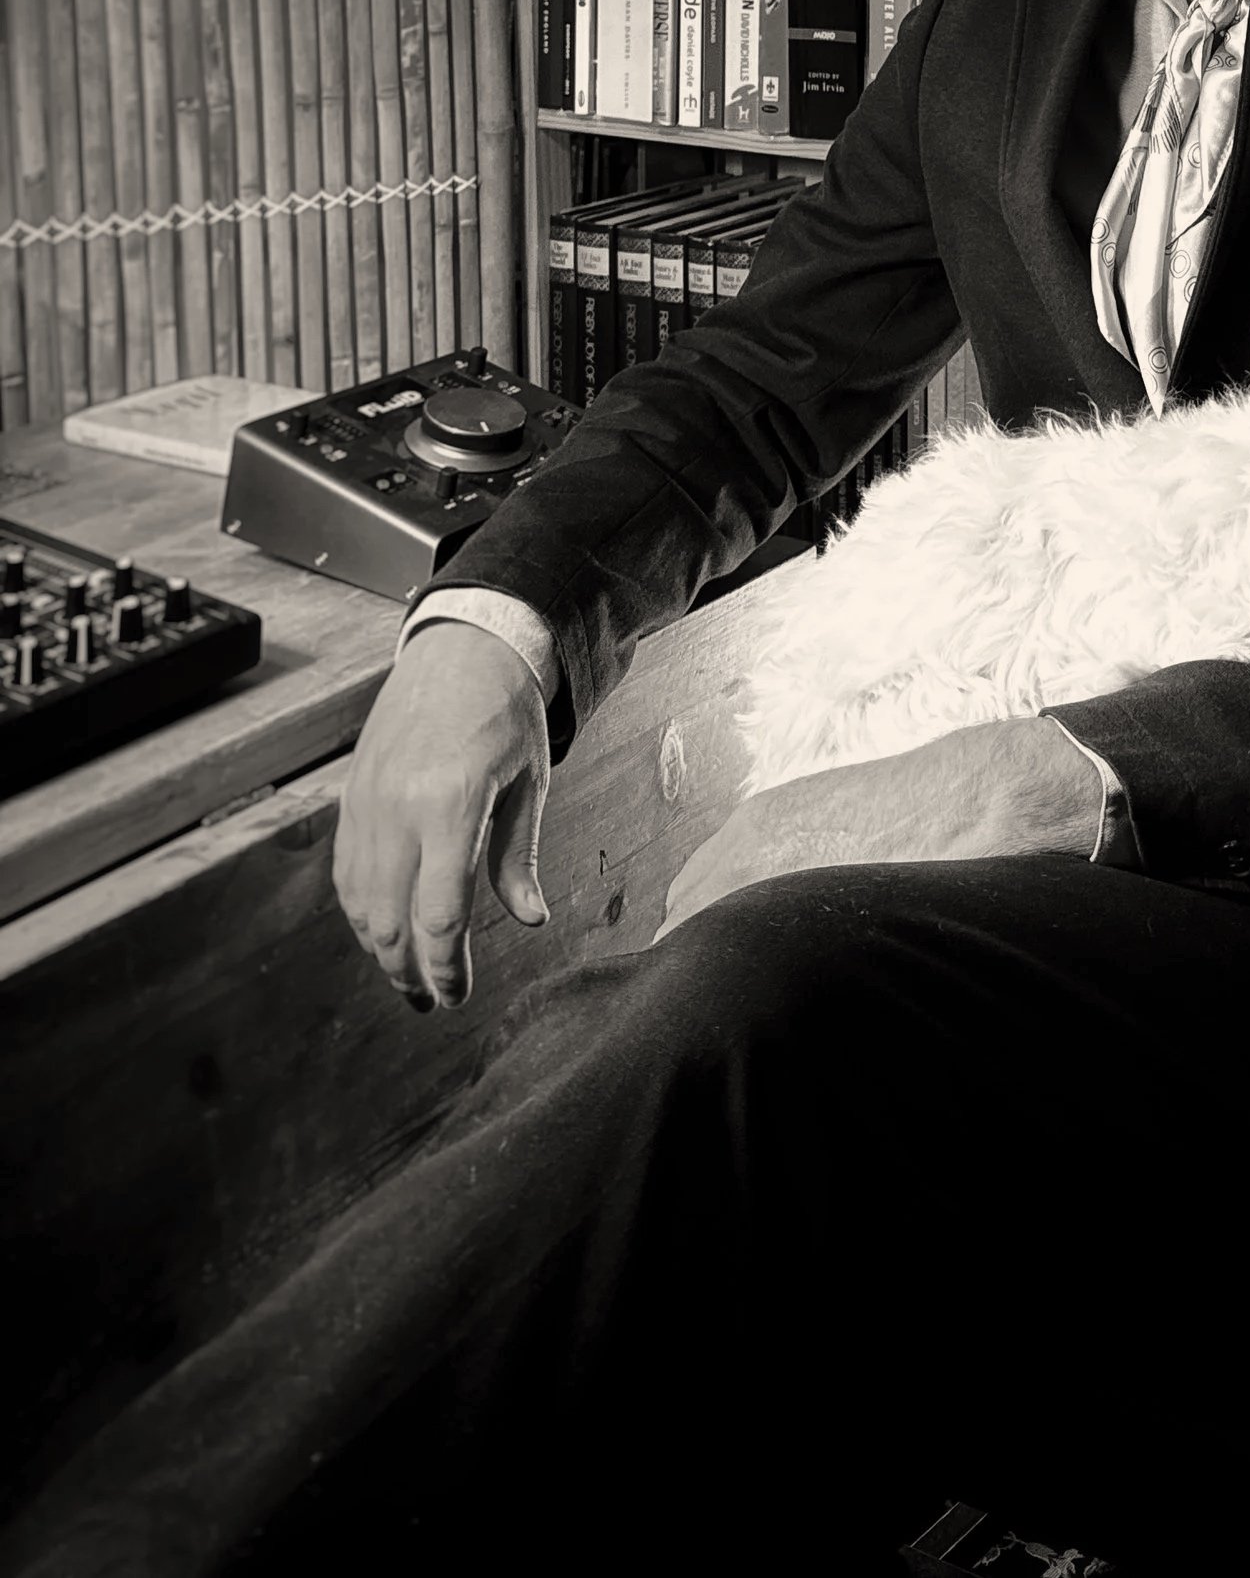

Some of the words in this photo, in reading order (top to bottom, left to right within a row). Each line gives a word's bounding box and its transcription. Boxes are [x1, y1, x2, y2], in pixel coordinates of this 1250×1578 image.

[686, 24, 696, 56] daniel
[813, 31, 836, 40] MOJO
[684, 59, 694, 88] coyle
[803, 81, 820, 93] Jim
[823, 83, 844, 93] Irvin
[585, 297, 595, 334] RIGBY
[585, 336, 595, 363] JOY
[585, 365, 594, 388] OF
